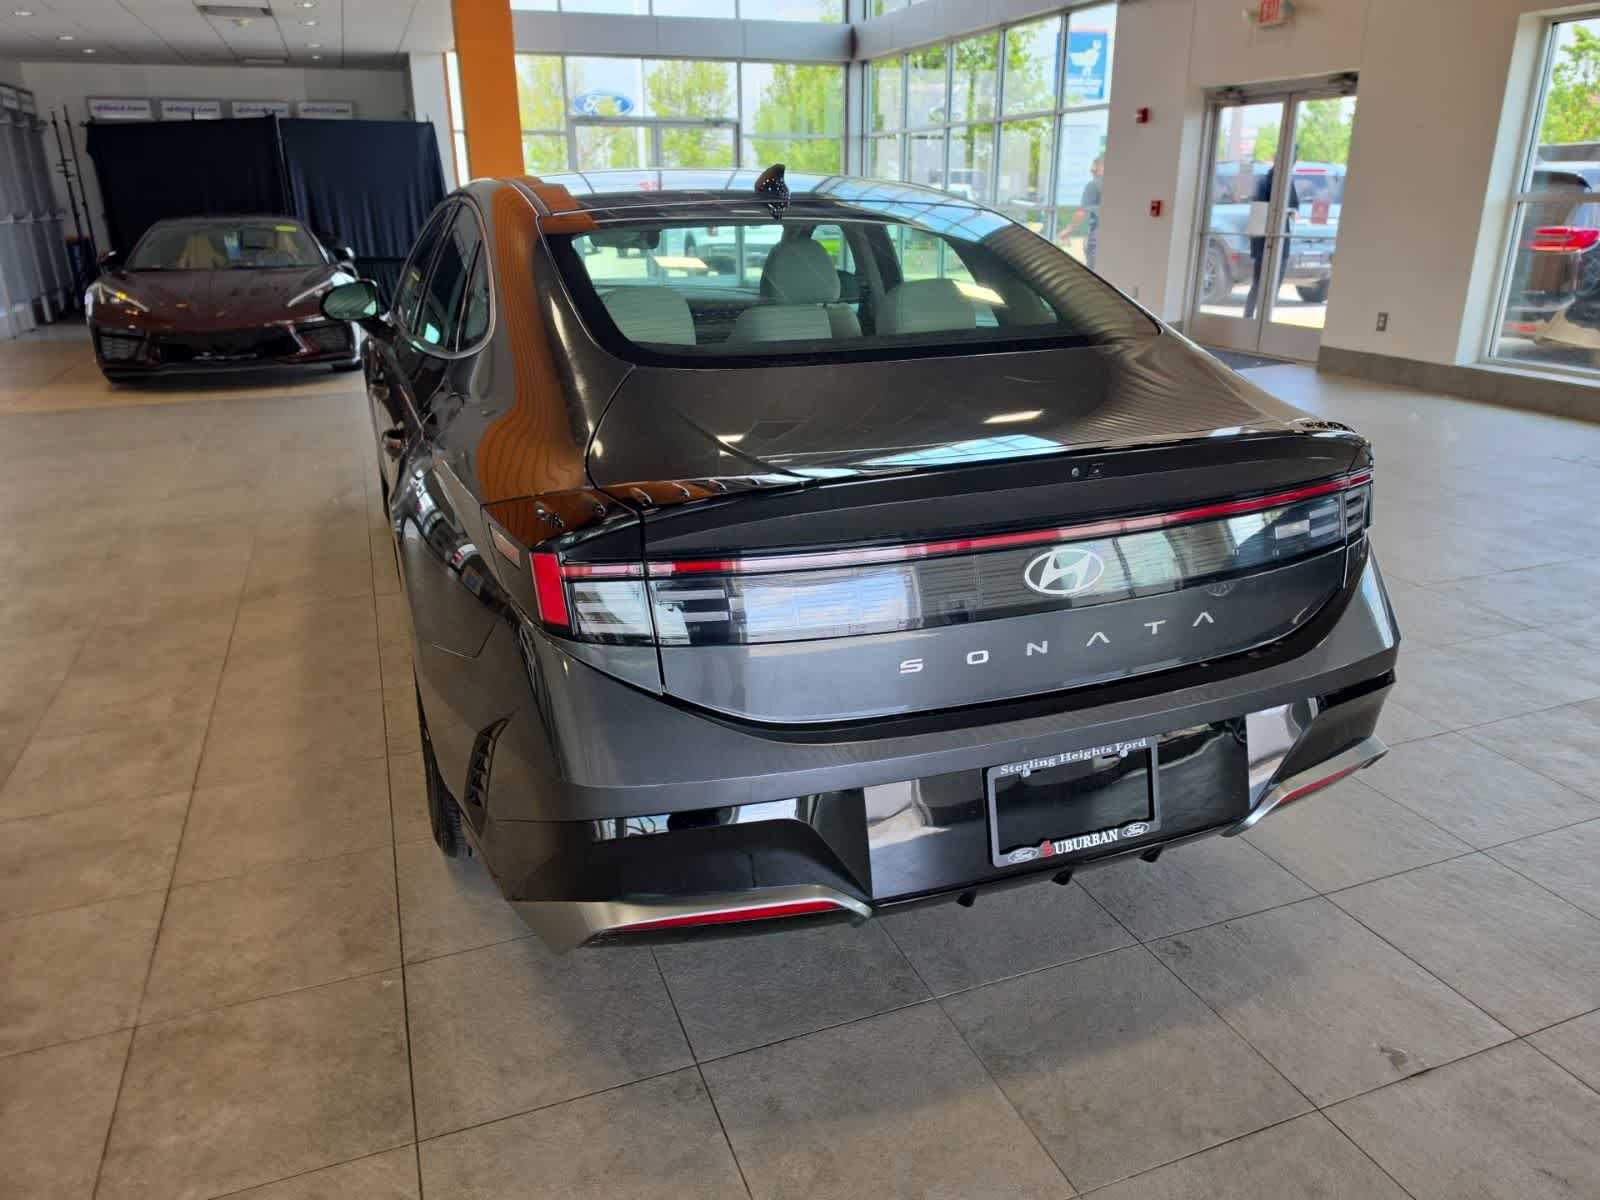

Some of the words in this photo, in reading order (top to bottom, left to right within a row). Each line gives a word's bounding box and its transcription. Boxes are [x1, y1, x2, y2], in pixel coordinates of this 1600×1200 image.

[899, 611, 1215, 675] SONATA
[1000, 757, 1057, 775] Sterling
[1060, 747, 1113, 764] Heights
[1116, 738, 1147, 754] Ford
[1040, 828, 1119, 858] SUBURBAN
